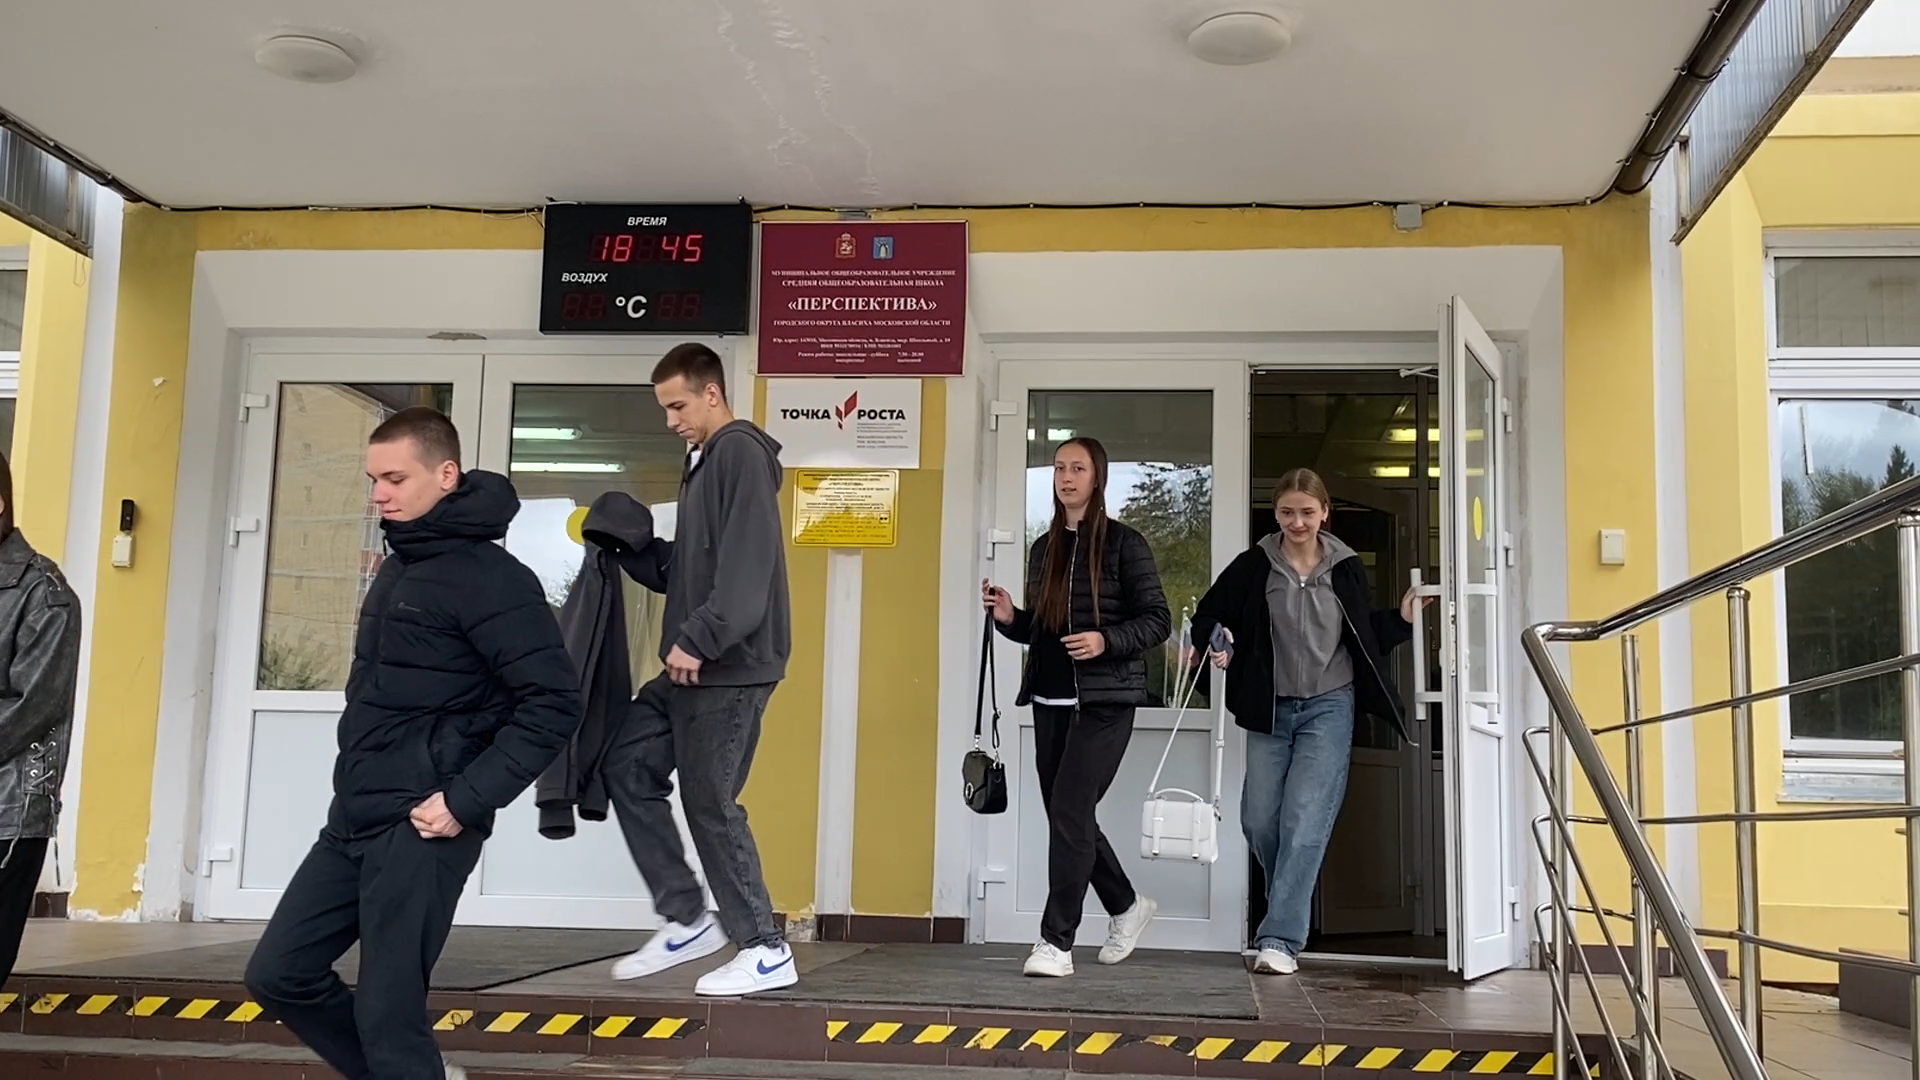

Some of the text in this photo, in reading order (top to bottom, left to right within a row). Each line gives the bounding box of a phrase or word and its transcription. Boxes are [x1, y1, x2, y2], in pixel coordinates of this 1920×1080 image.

[627, 216, 668, 226] ВРЕМЯ
[602, 235, 703, 262] 18 45
[561, 272, 609, 284] ВОЗДУХ
[782, 279, 944, 287] СРЕДНЯЯ ОБЩЕОБРАЗОВАТЕЛЬНАЯ ШКОЛА
[788, 297, 938, 311] «ПЕРСПЕКТИВА»
[874, 318, 919, 326] МОСКОВСКОЙ
[780, 409, 906, 420] ТОЧКА РОСТА
